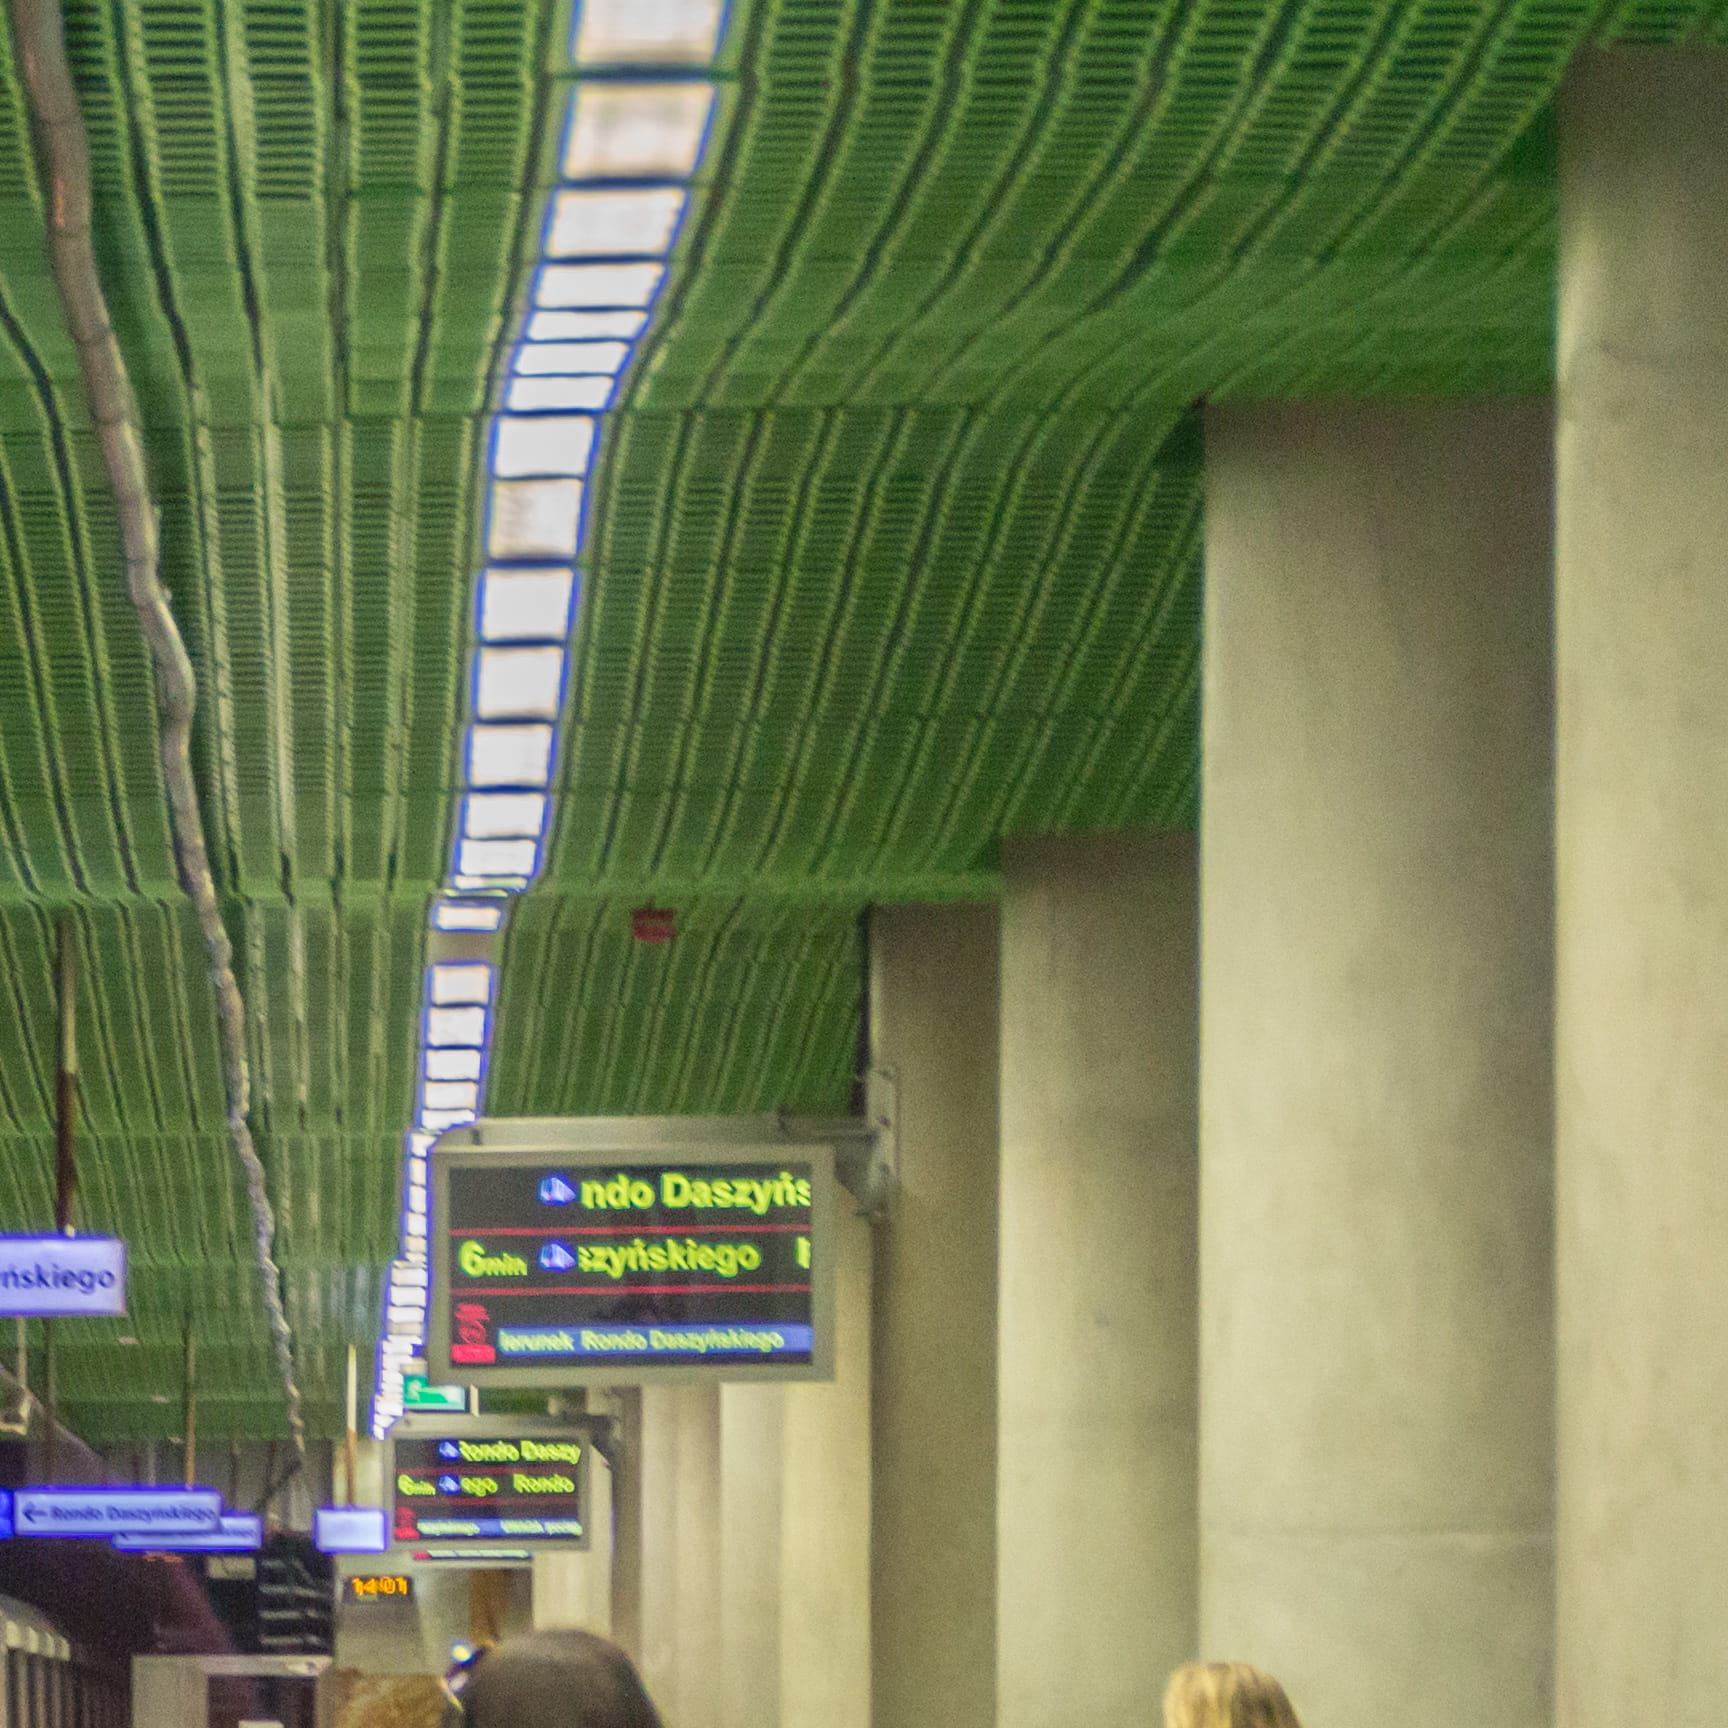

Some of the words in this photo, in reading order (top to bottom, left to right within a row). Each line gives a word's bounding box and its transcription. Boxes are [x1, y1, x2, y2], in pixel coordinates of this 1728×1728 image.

[581, 1174, 655, 1210] ndo
[459, 1240, 528, 1278] 6min
[580, 1328, 648, 1351] Rondo
